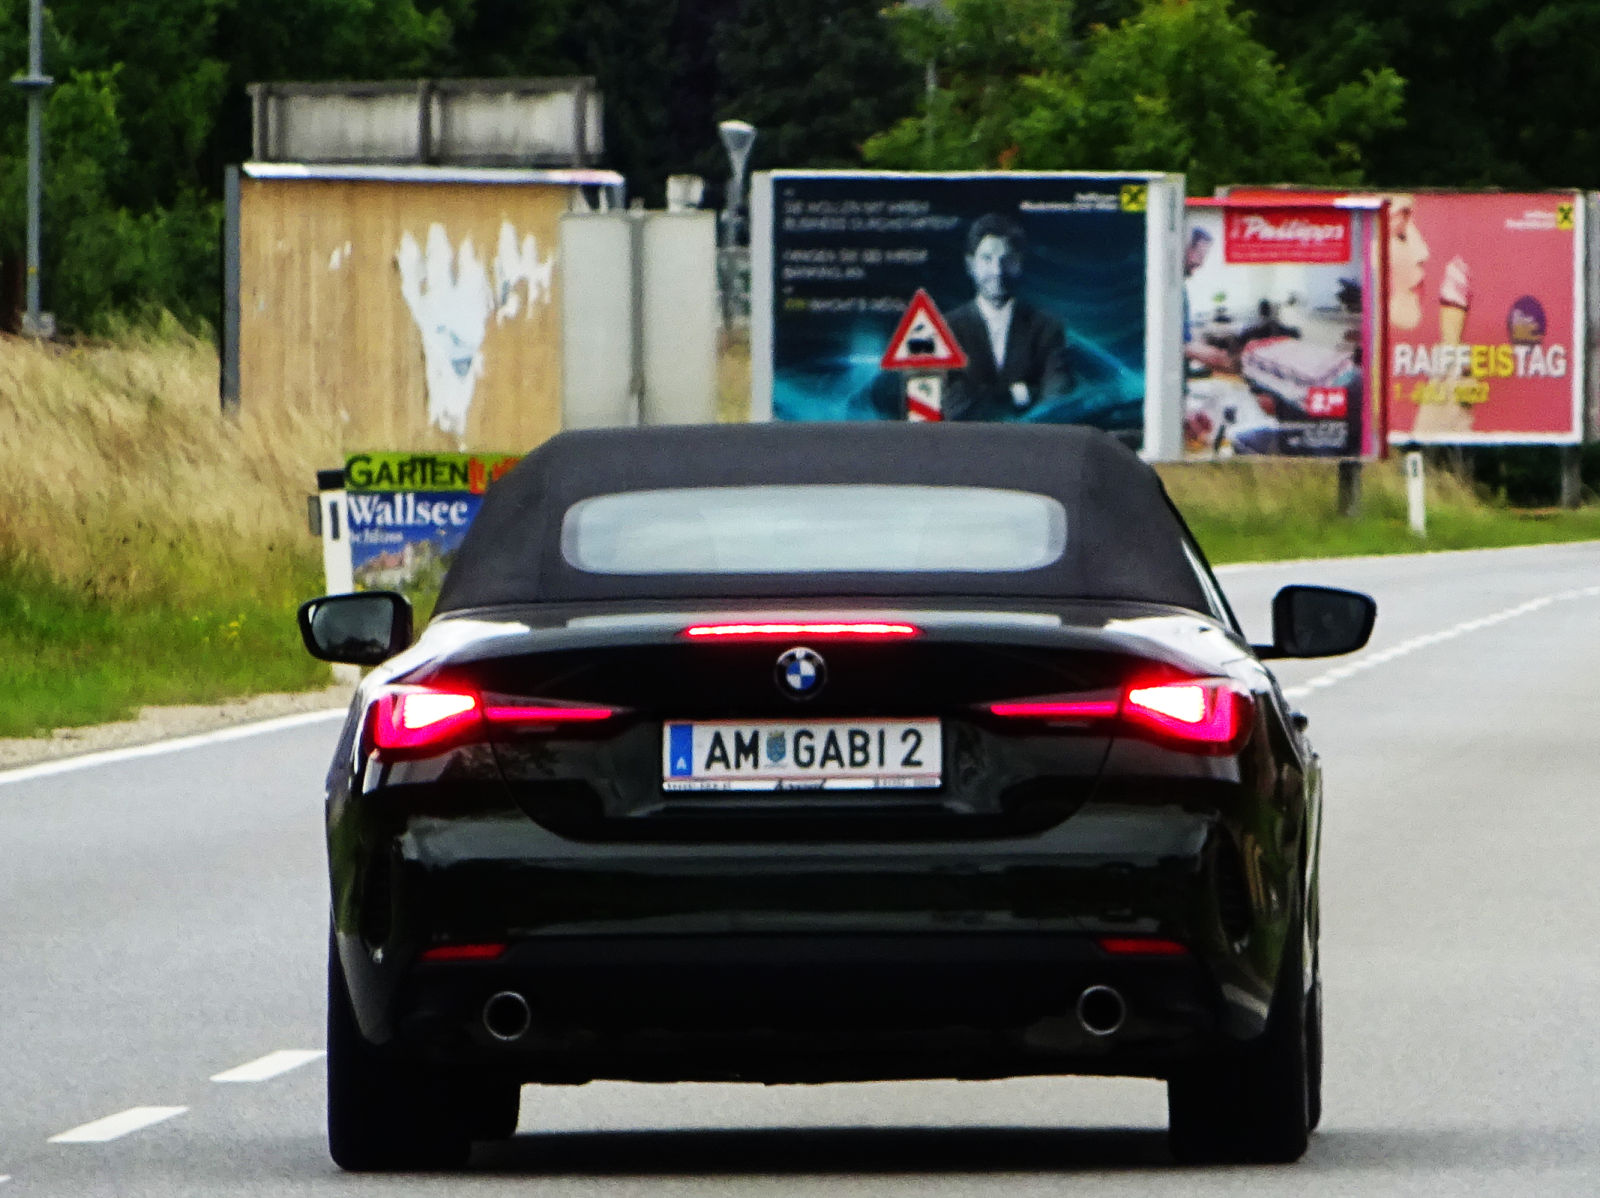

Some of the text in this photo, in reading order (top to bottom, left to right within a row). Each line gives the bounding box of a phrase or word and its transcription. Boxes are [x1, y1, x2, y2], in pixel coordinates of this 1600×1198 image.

[1393, 343, 1567, 378] RAIFFEISTAG
[347, 492, 469, 526] Wallsee
[675, 756, 688, 771] A
[704, 727, 924, 770] AM GABI 2
